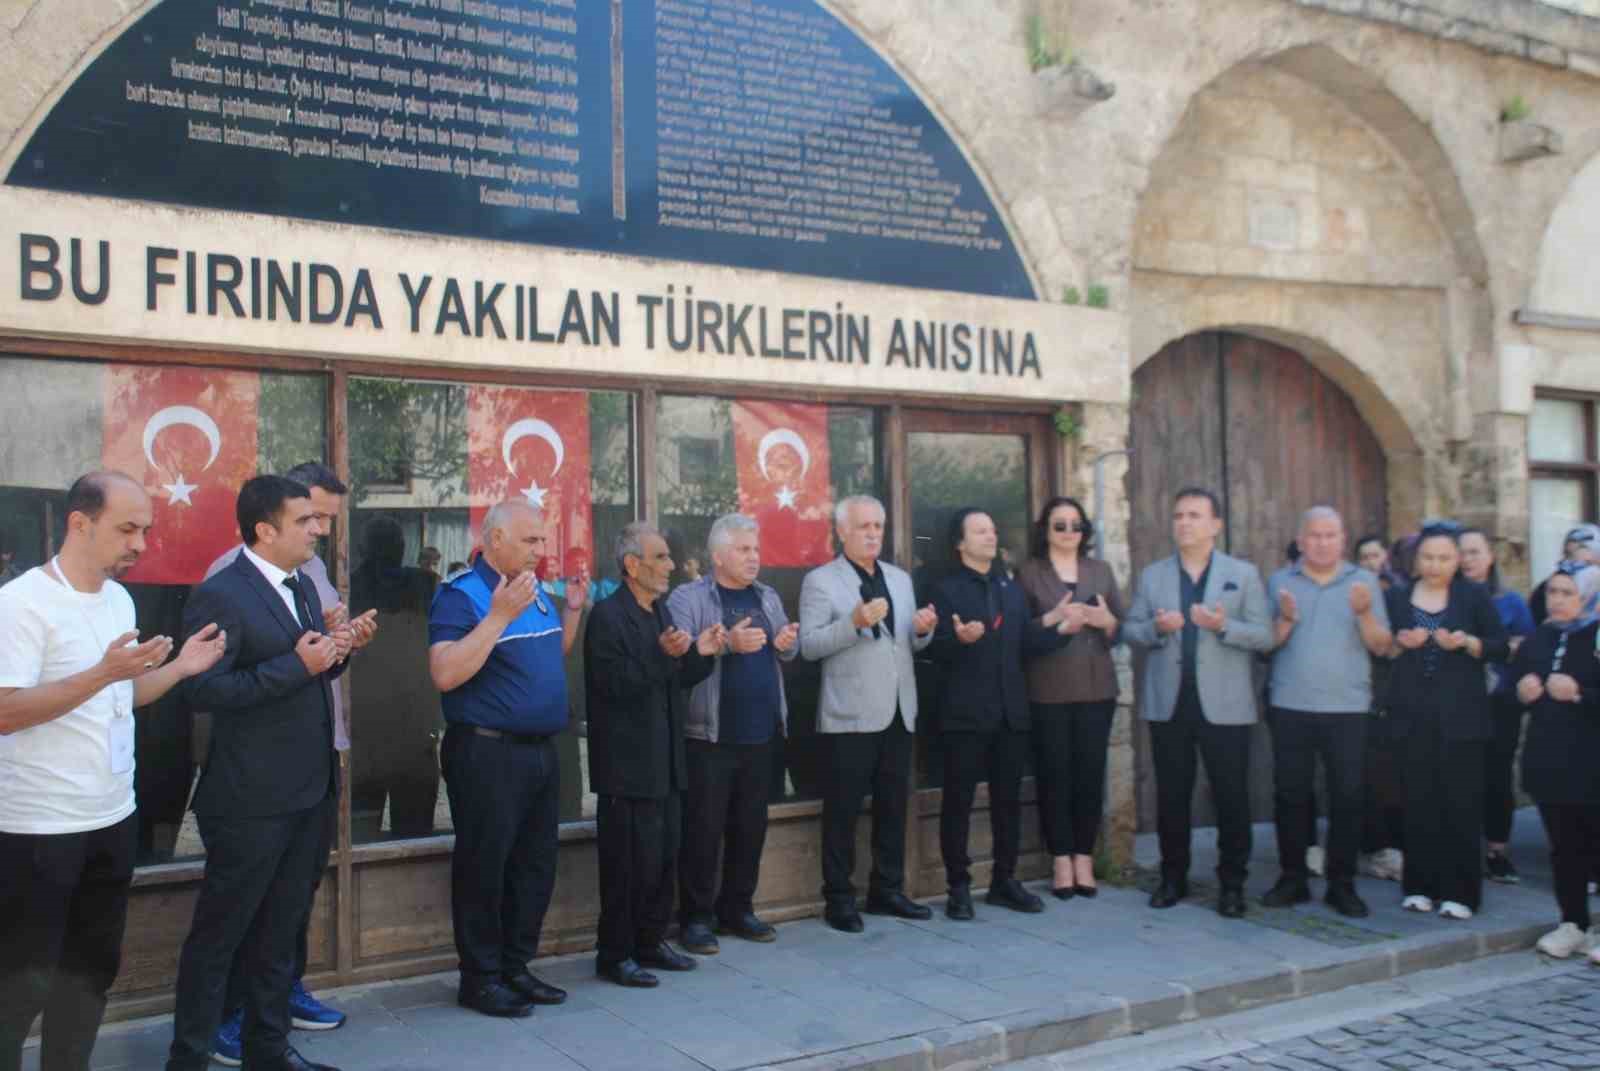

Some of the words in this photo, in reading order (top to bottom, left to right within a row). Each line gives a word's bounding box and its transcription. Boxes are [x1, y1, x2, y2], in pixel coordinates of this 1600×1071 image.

[19, 233, 111, 305] BU
[145, 246, 384, 330] FIRINDA
[397, 272, 621, 346] YAKILAN
[636, 284, 870, 364] TÜRKLERİN
[885, 319, 1042, 378] ANISINA
